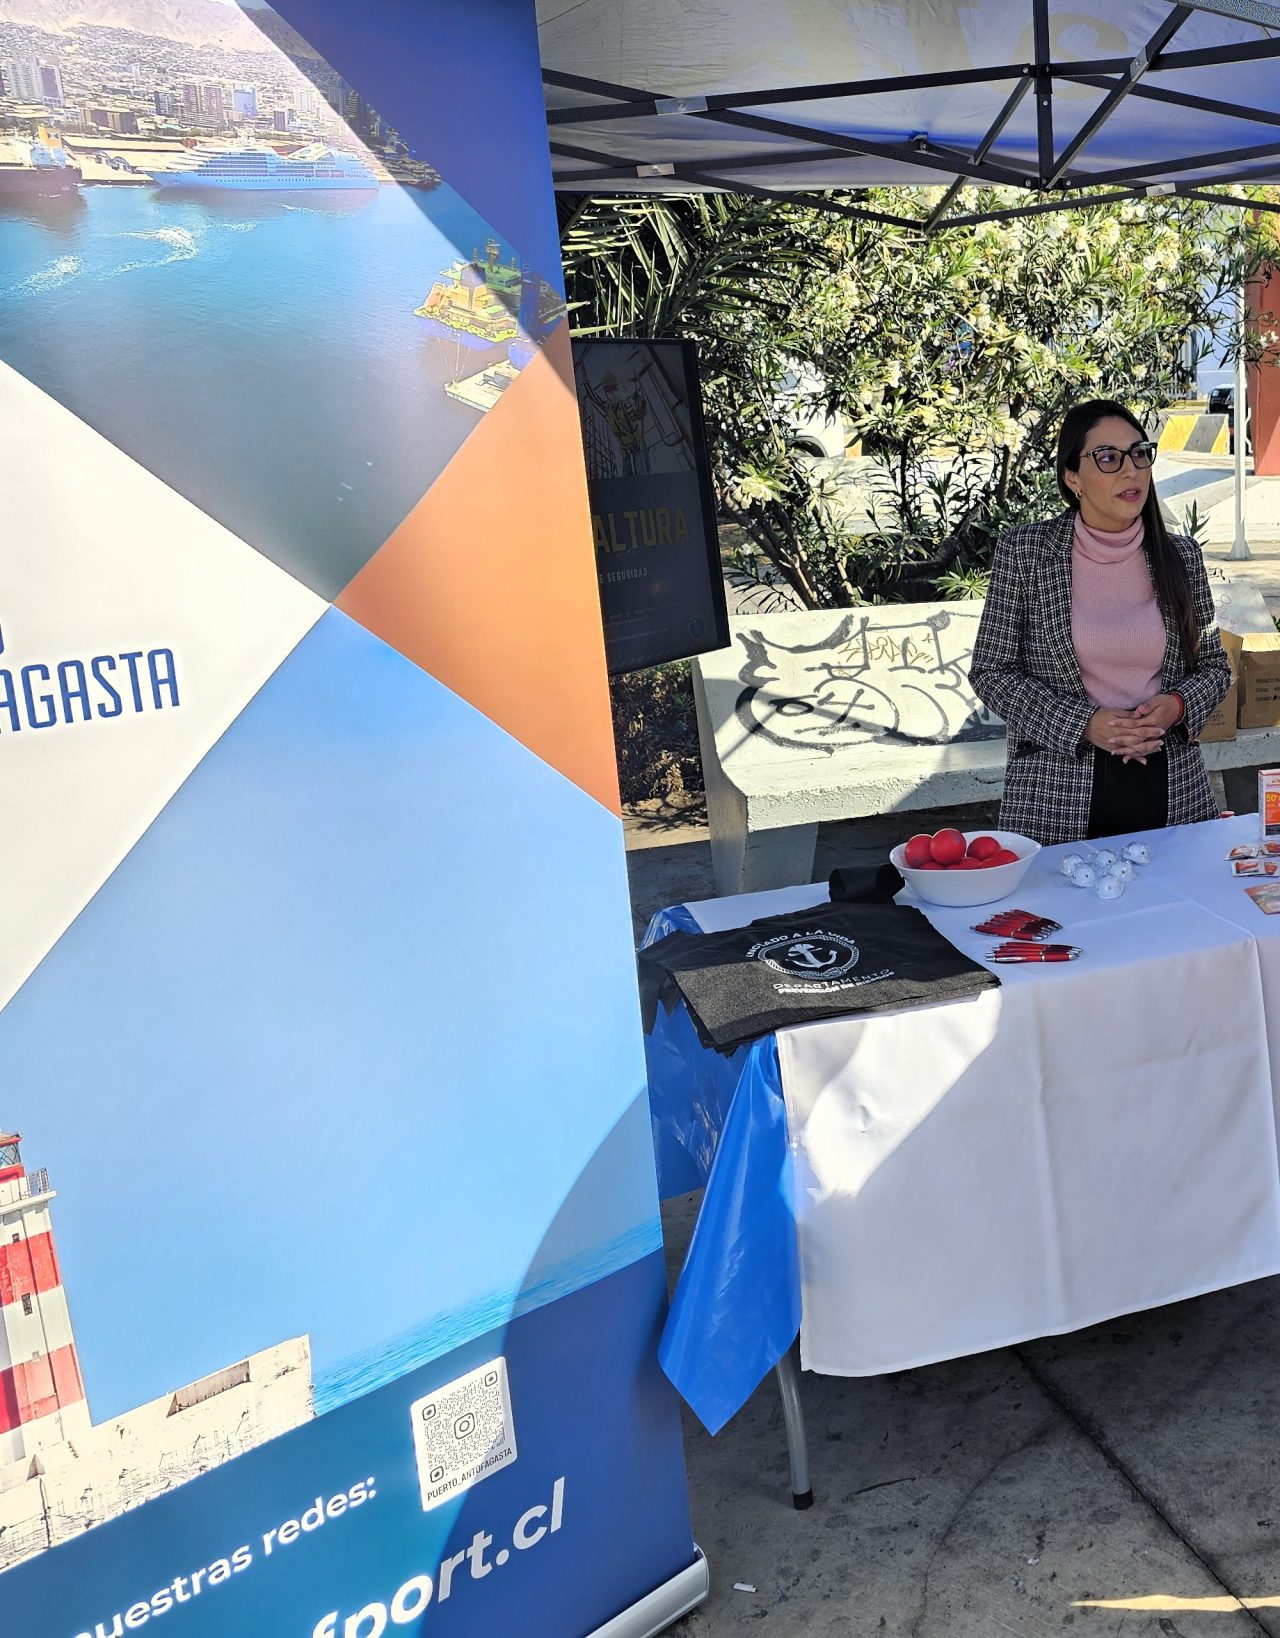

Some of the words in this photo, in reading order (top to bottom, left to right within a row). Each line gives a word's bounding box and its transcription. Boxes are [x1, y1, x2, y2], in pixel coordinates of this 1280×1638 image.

[593, 506, 690, 554] ALTURA
[607, 567, 648, 583] SEGURIDAD
[427, 1448, 513, 1501] PUERTO_ANTOFAGASTA
[262, 1477, 377, 1556] redes:
